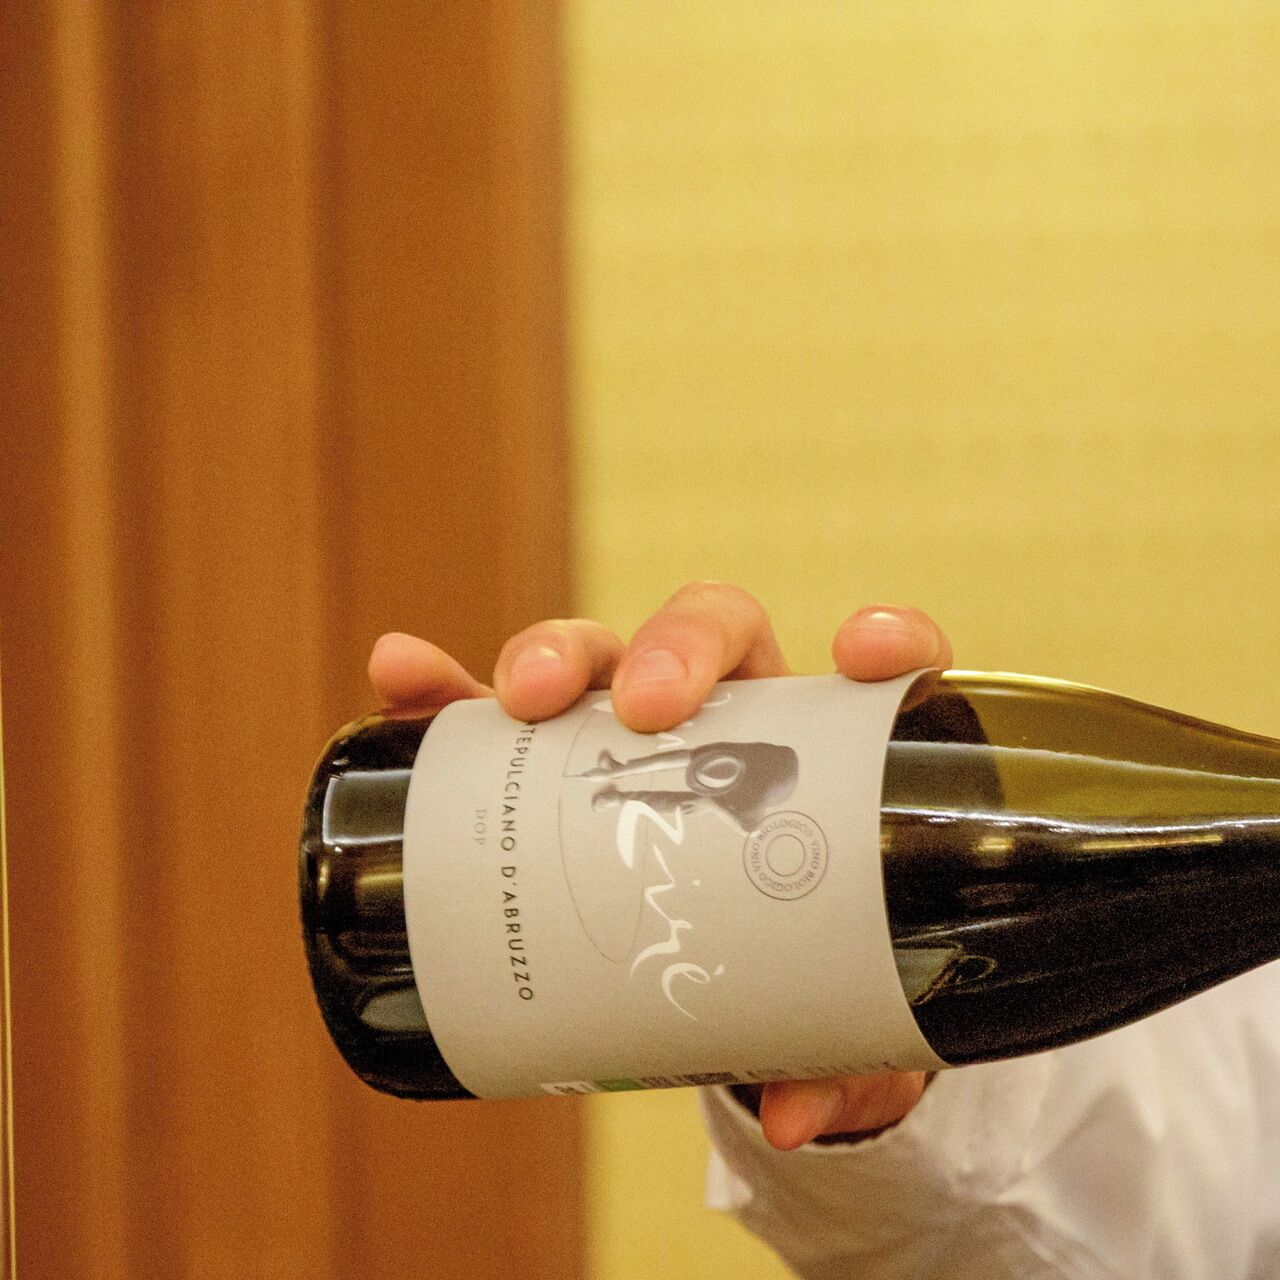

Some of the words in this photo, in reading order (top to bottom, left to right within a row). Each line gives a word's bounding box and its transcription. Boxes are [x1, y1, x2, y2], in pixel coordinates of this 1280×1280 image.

[473, 808, 487, 846] DOP
[500, 721, 537, 852] TEPULCIANO
[500, 866, 534, 1002] D'ABRUZZO
